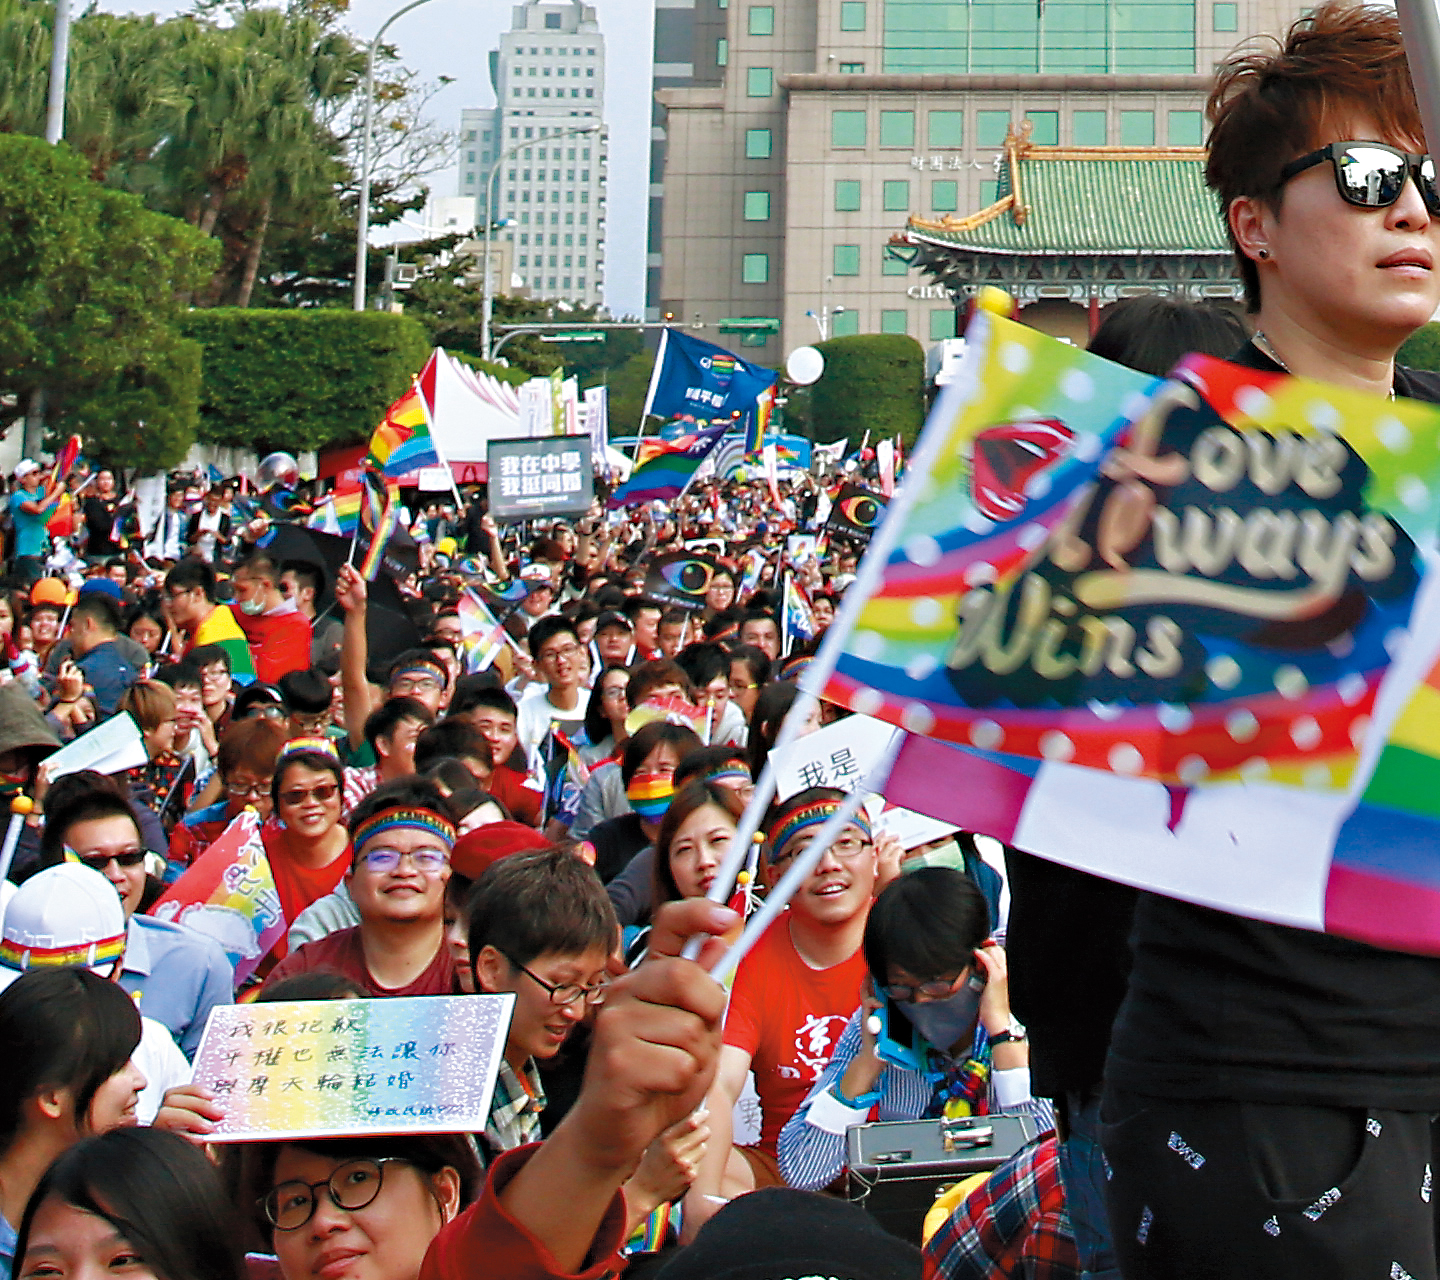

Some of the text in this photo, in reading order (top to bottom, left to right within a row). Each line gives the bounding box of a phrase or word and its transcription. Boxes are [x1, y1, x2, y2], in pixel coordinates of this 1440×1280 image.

[1100, 375, 1356, 500] Love
[948, 570, 1186, 680] Wins
[798, 747, 859, 789] 我是
